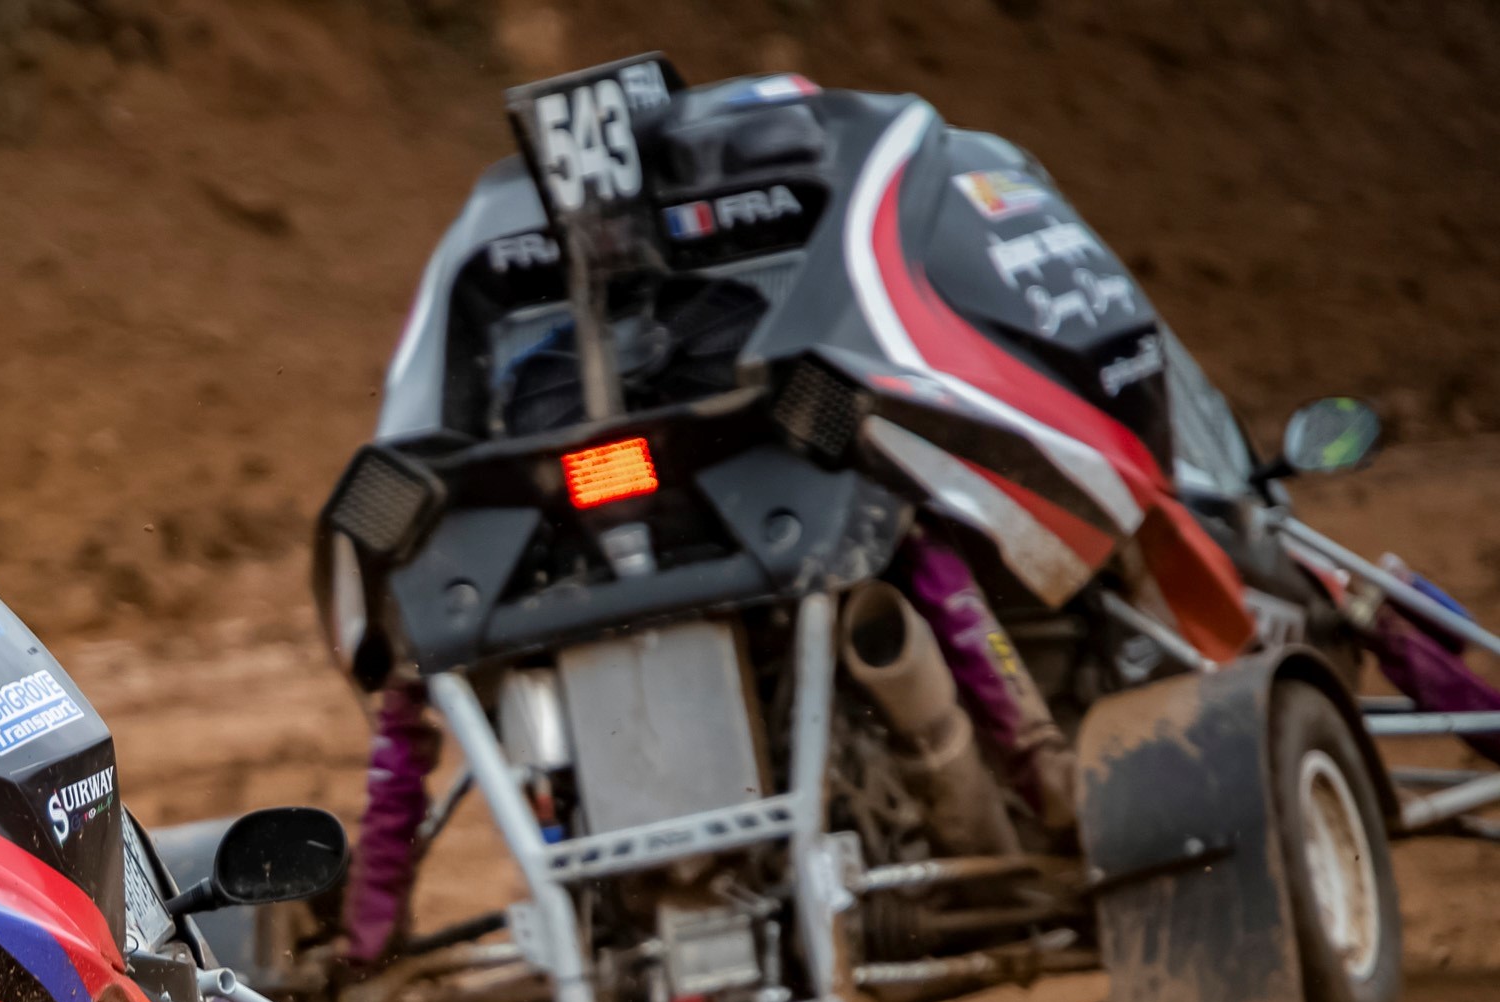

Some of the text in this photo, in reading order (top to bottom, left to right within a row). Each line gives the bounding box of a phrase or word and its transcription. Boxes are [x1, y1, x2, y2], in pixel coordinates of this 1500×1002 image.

[535, 79, 642, 212] 543
[714, 184, 802, 229] FRA
[48, 765, 114, 847] SUIRWAY
